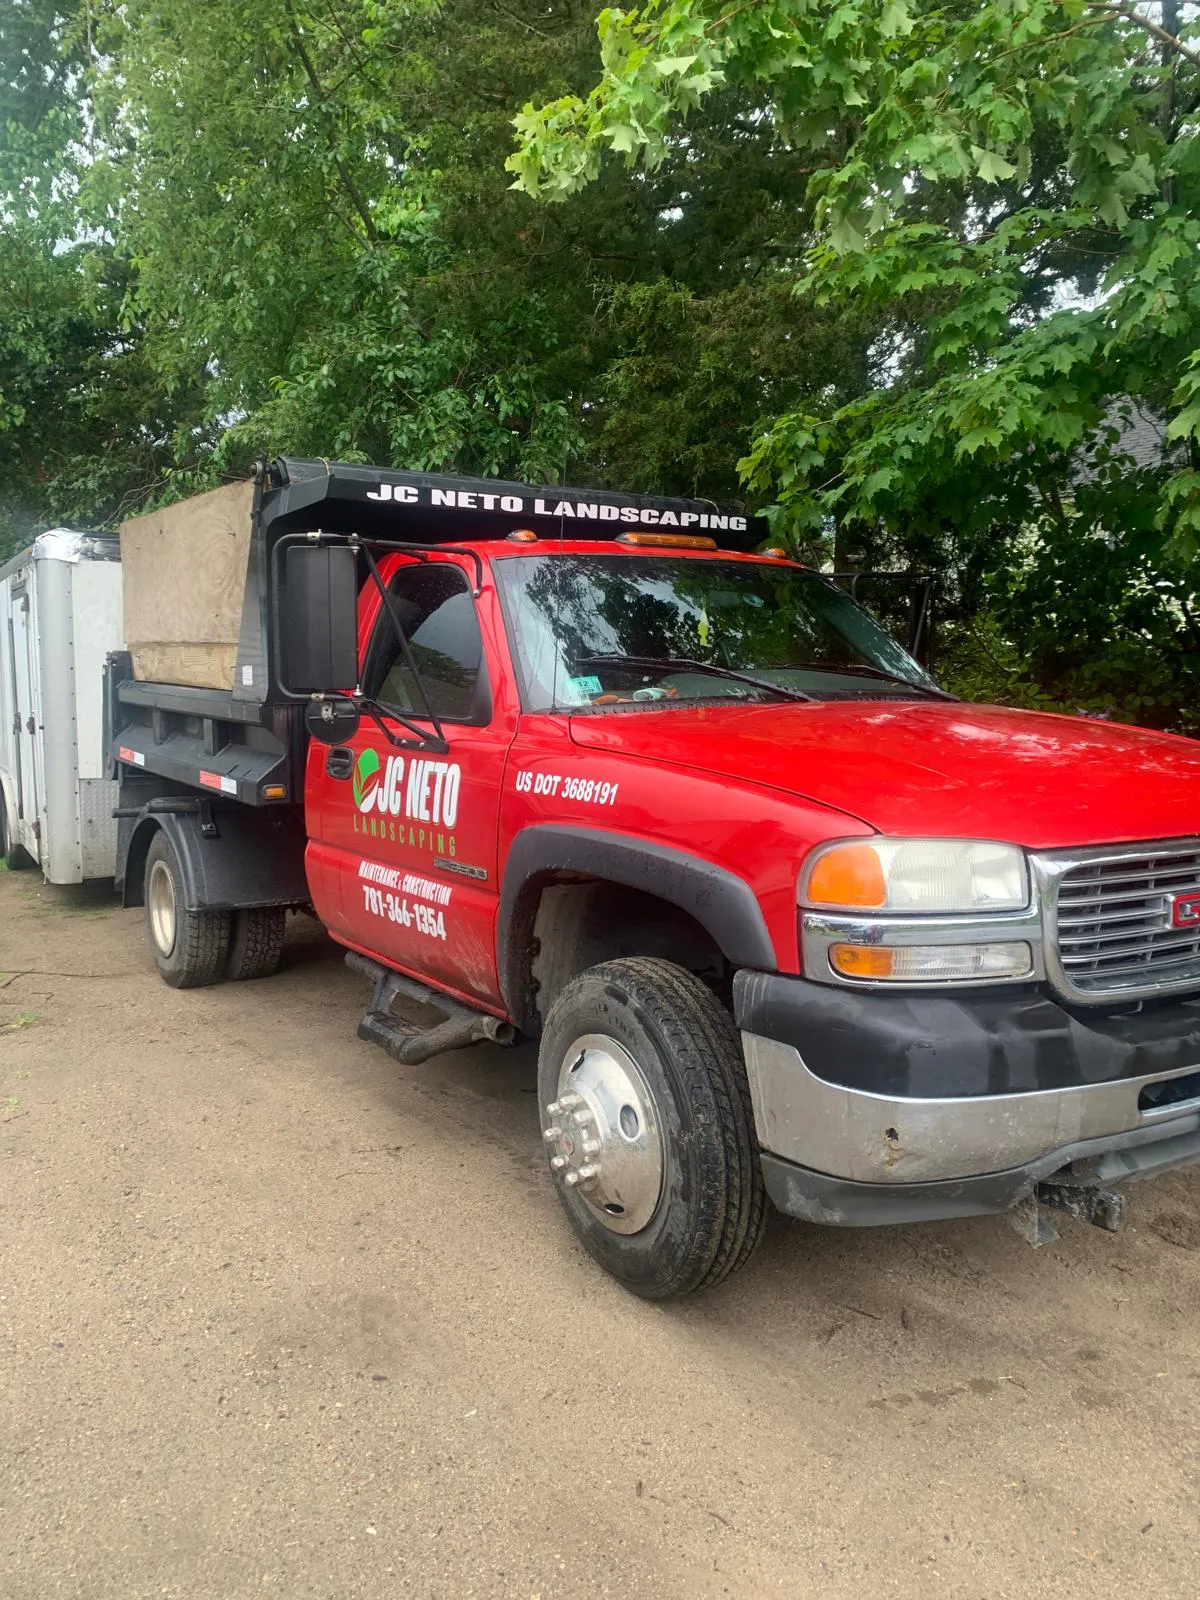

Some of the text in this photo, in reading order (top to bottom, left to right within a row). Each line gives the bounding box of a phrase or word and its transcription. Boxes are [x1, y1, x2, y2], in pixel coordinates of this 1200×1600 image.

[367, 484, 748, 531] JC NETO LANDSCAPING
[377, 755, 461, 830] JC NETO
[515, 770, 619, 806] US DOT 3688191
[353, 814, 456, 857] LANDSCAPING
[362, 884, 447, 940] 781-366-1354
[402, 873, 453, 907] CONSTRUCTION
